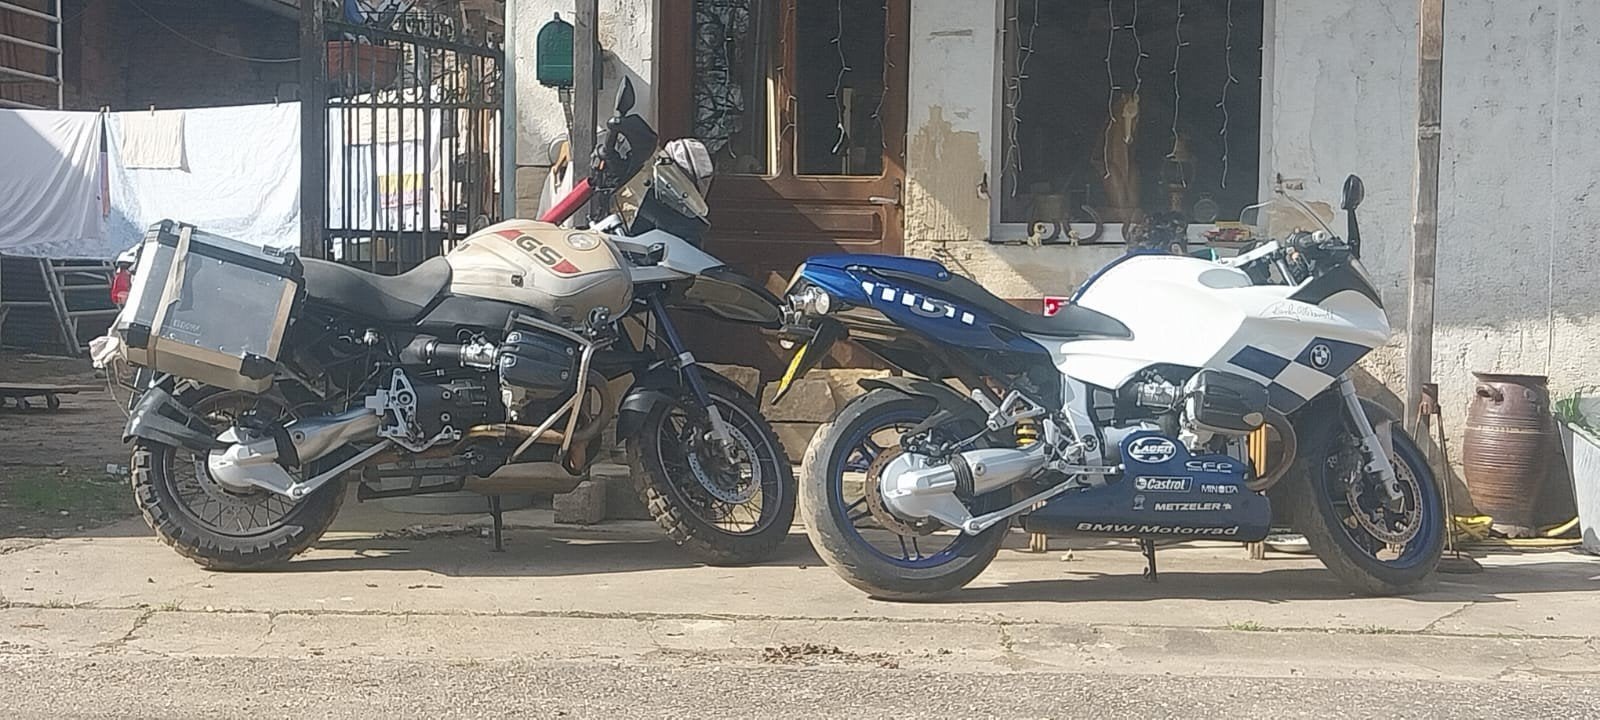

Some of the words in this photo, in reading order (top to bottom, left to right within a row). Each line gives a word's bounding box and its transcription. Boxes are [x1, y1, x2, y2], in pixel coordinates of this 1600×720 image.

[516, 235, 563, 266] GS
[1147, 478, 1186, 490] Castrol
[1201, 484, 1239, 494] MINOLTA
[1154, 502, 1221, 511] METZELER
[1076, 522, 1136, 532] BMW
[1138, 524, 1239, 535] Motorrad
